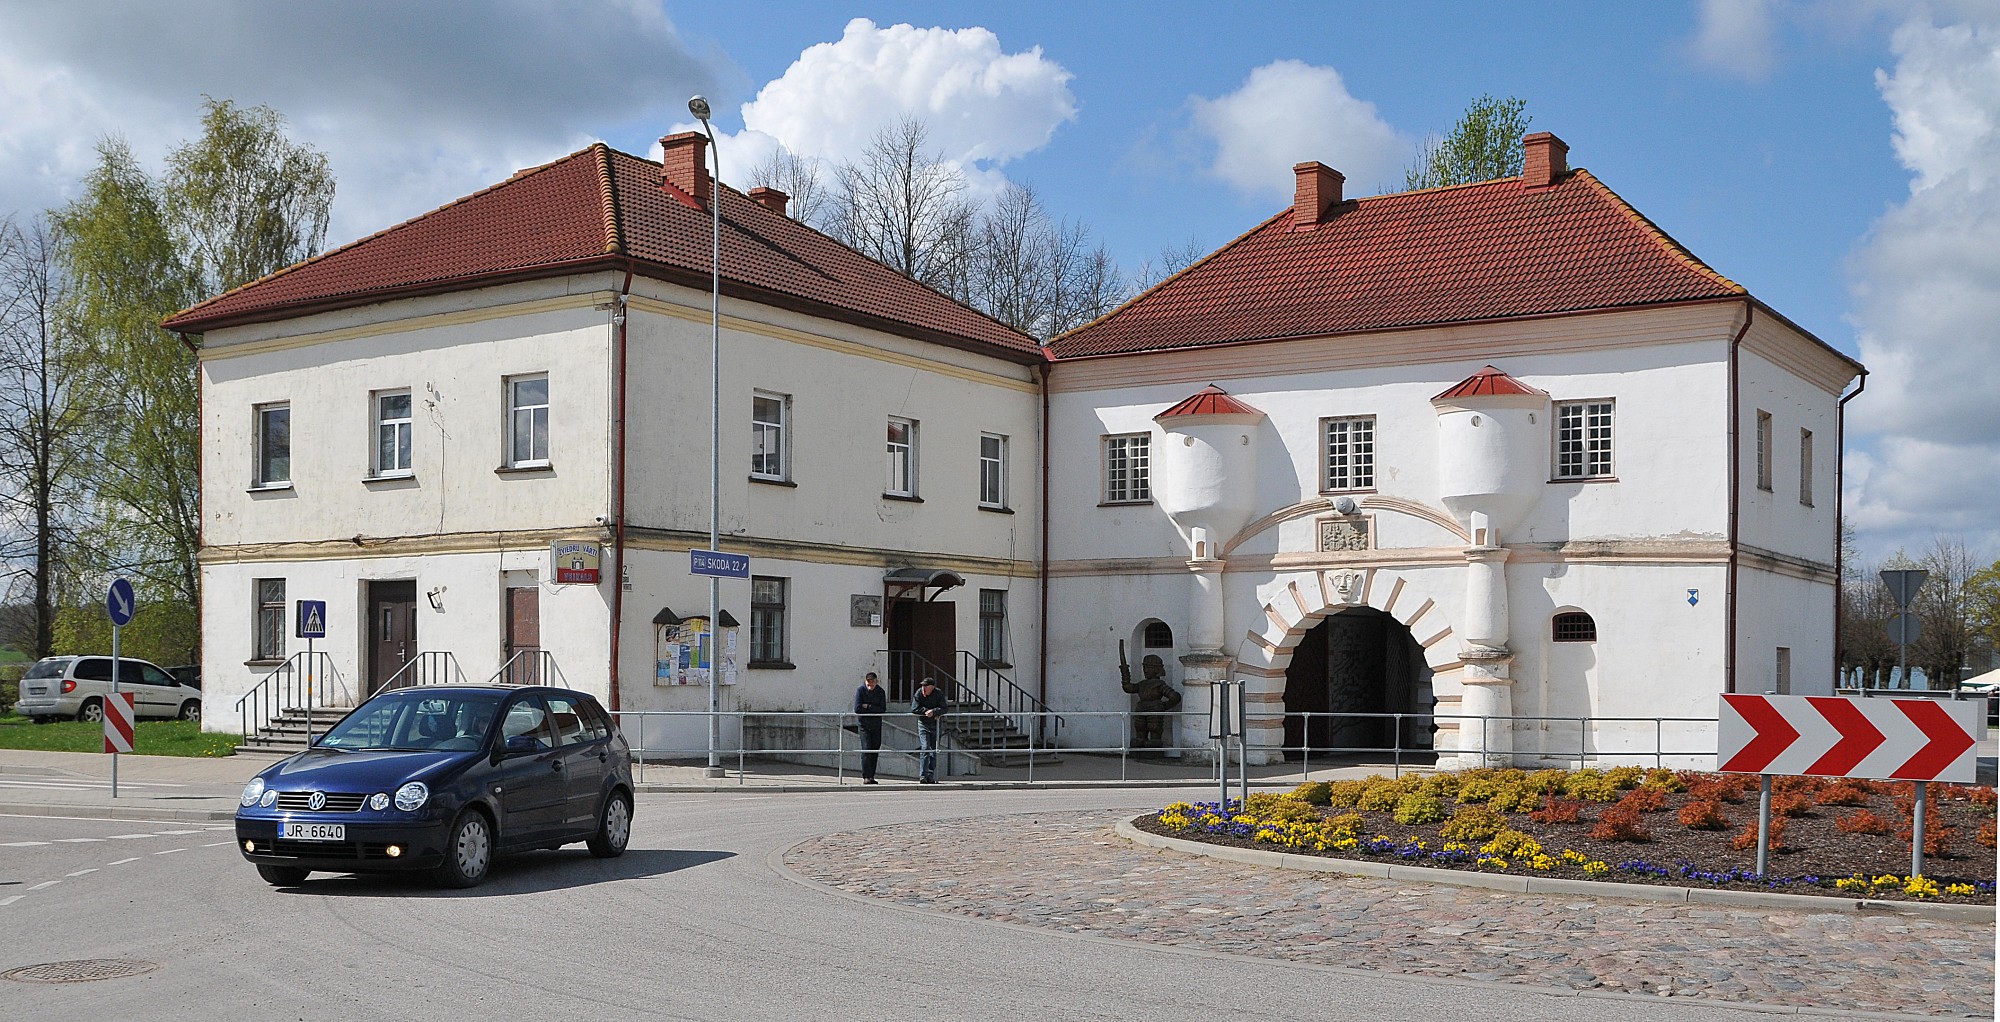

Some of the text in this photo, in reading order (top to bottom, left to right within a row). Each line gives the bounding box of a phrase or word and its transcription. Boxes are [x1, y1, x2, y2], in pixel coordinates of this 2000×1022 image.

[707, 558, 730, 571] SKODA
[732, 560, 740, 571] 22
[287, 824, 343, 838] JR-6640
